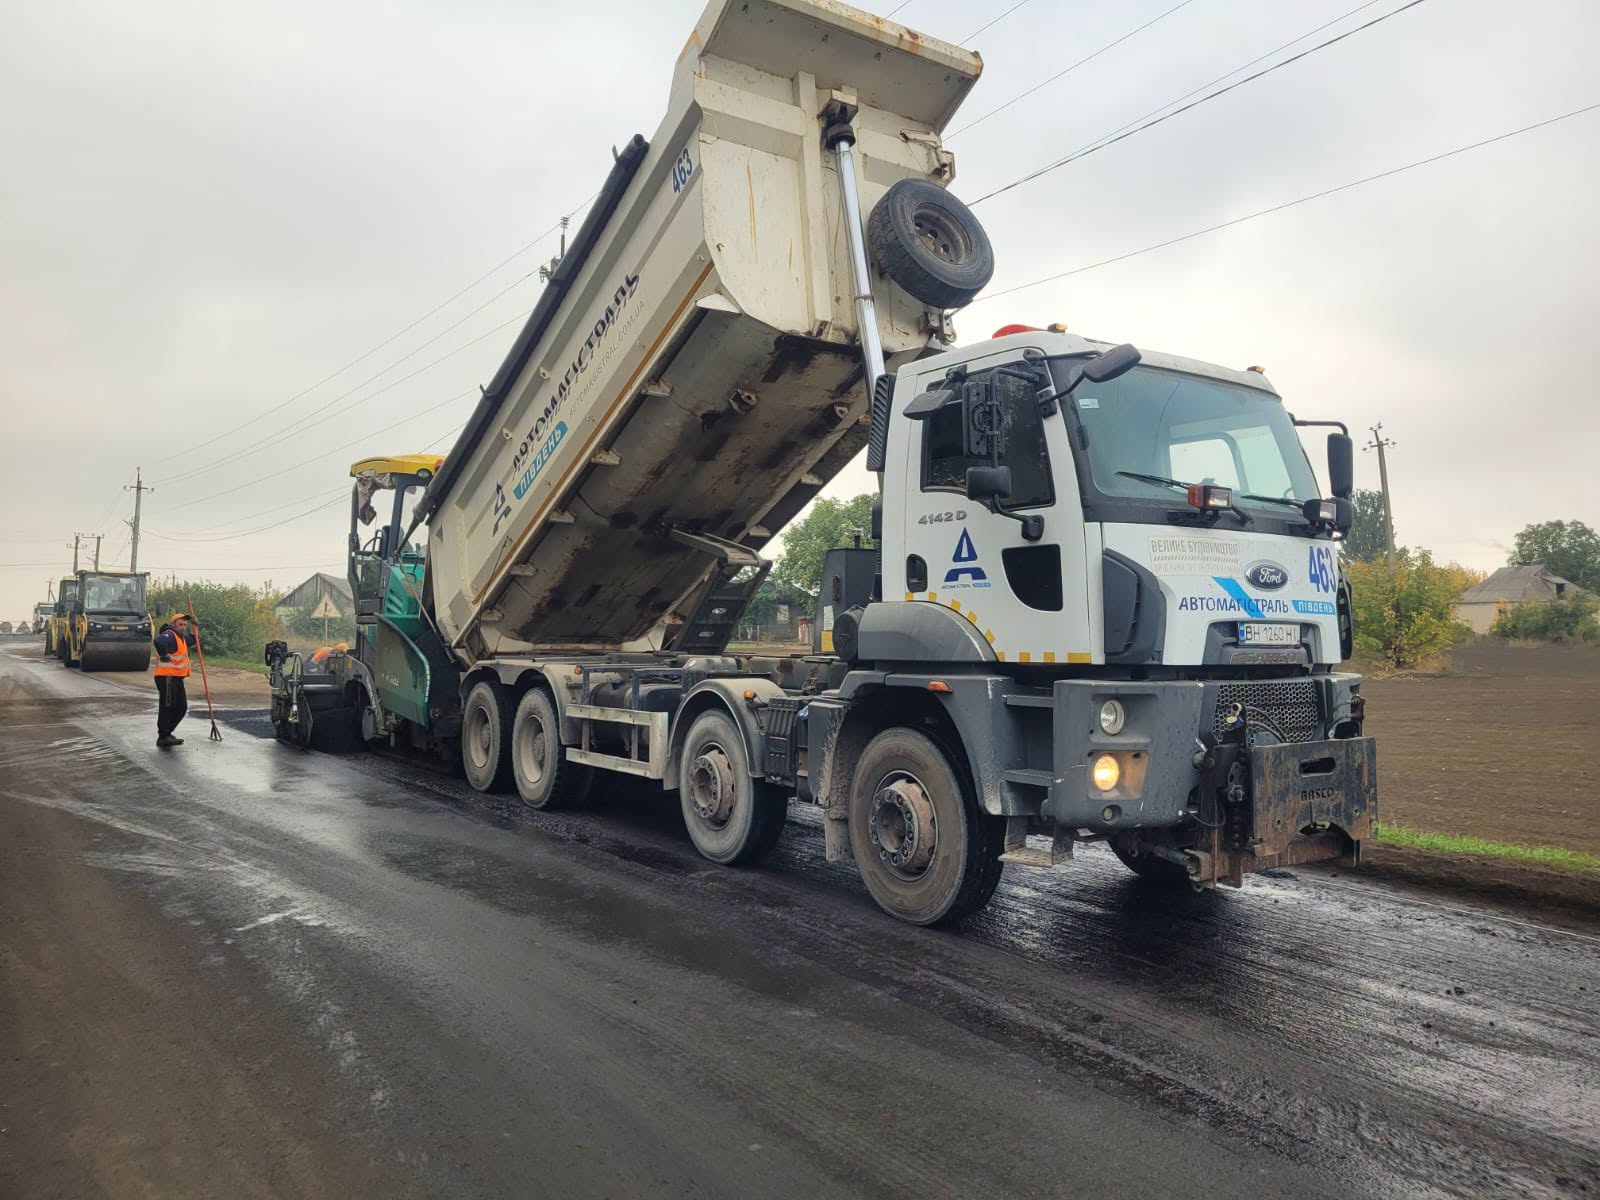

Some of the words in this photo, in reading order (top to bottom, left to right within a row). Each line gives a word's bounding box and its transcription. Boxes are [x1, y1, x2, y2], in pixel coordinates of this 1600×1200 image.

[672, 147, 693, 194] 463
[519, 429, 563, 494] ПІВДЕНЬ
[918, 511, 954, 525] 4142
[955, 510, 967, 521] D
[1151, 540, 1187, 553] ВЕЛИКЕ
[1258, 567, 1282, 584] Ford
[1308, 546, 1336, 593] 463
[1178, 597, 1289, 613] АВТОМАГІСТРАЛЬ
[1298, 602, 1333, 612] ПІВДЕНЬ
